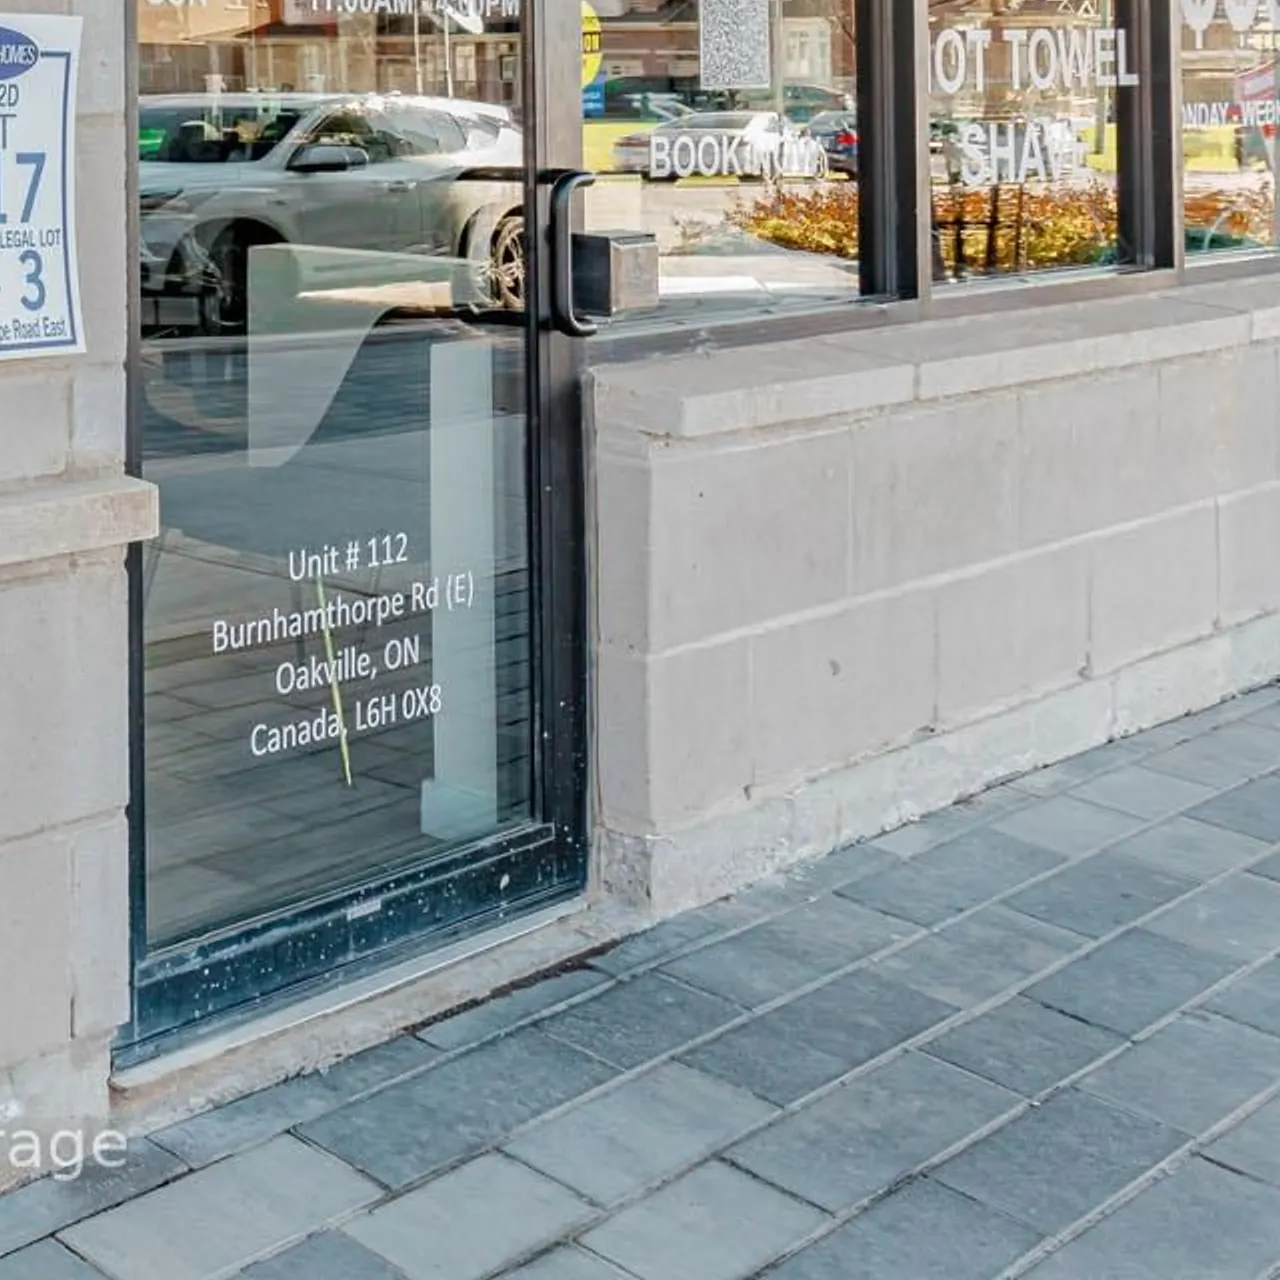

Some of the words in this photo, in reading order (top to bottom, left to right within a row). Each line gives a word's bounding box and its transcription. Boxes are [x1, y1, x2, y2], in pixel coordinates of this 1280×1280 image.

[1002, 27, 1140, 91] TOWEL
[649, 135, 742, 178] BOOK
[0, 229, 36, 249] LEGAL
[40, 228, 61, 246] LOT
[19, 249, 46, 311] 3
[13, 319, 41, 339] Road
[43, 316, 68, 337] East
[289, 544, 339, 581] Unit
[346, 541, 360, 570] #
[367, 532, 408, 568] 112
[212, 591, 404, 653] Burnhamthorpe
[412, 577, 438, 612] Rd
[446, 570, 474, 610] (E)
[275, 645, 378, 695] Oakville,
[384, 634, 420, 670] ON
[251, 707, 347, 757] Canada,
[356, 694, 396, 731] L6H
[401, 683, 442, 720] 0X8
